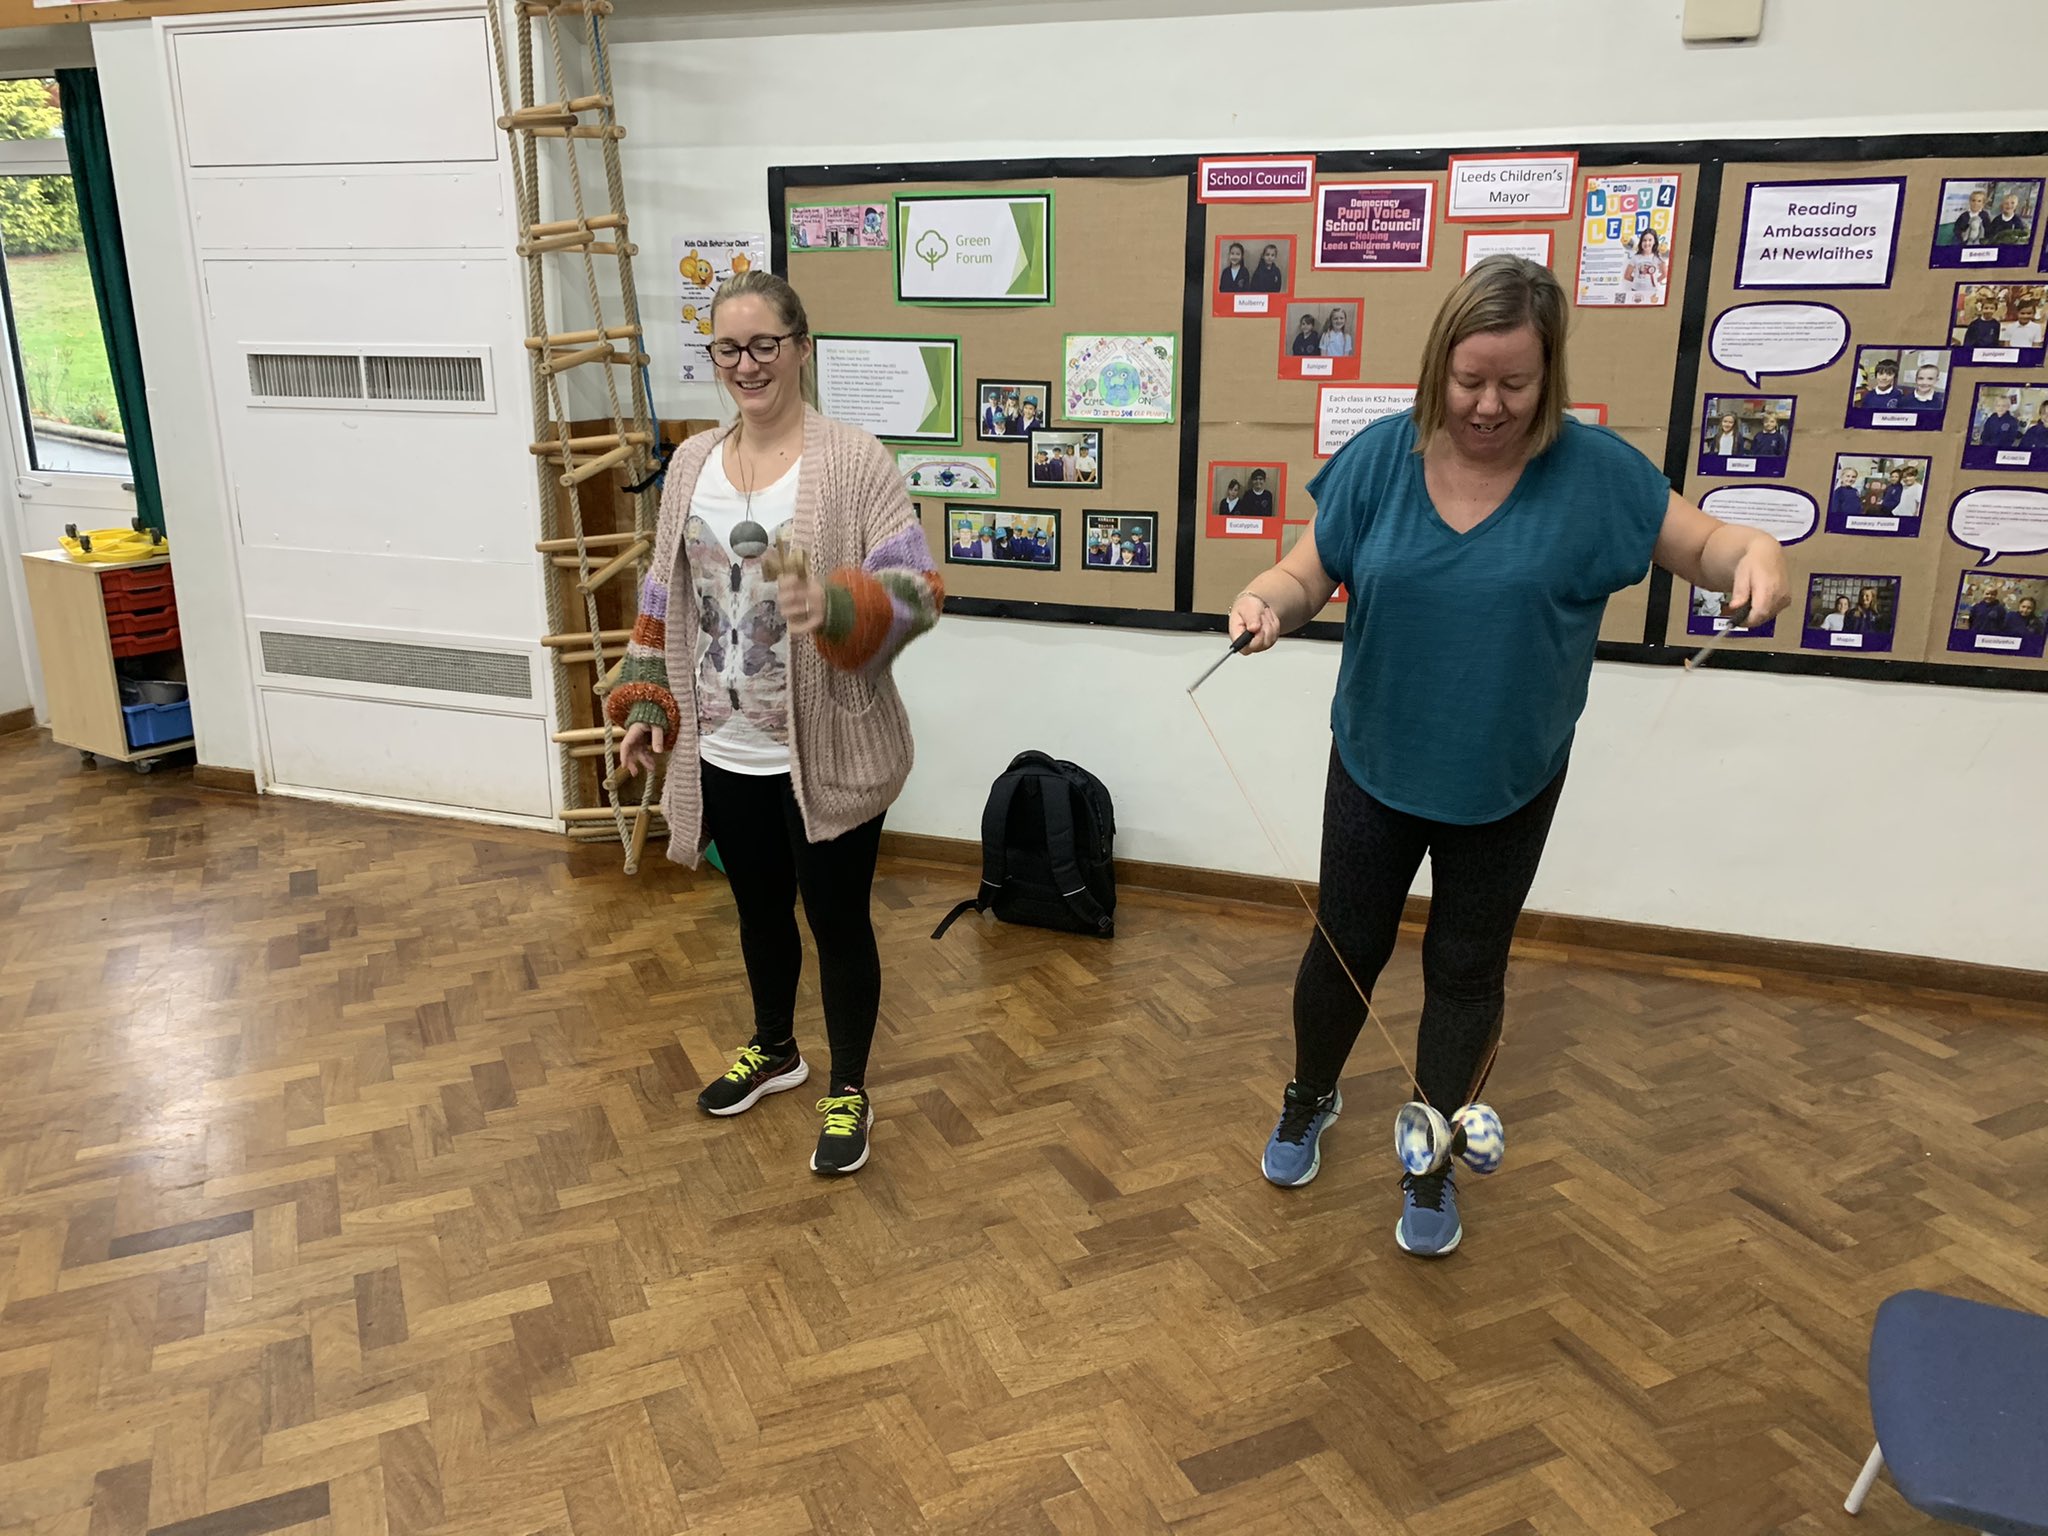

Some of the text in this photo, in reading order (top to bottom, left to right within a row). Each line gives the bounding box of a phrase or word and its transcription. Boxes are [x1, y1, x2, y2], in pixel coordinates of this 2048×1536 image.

[1209, 171, 1305, 185] School Council
[1461, 171, 1496, 182] Leeds
[1350, 198, 1400, 208] Democracy
[1489, 191, 1530, 204] Mayor
[1588, 186, 1674, 214] LUCY 4
[1337, 207, 1410, 220] Pupil Voice
[1787, 202, 1857, 217] Reading
[1325, 218, 1421, 231] School Council
[1588, 210, 1669, 241] LEEDS
[1763, 224, 1877, 238] Ambassadors
[955, 234, 991, 247] Green
[1355, 231, 1389, 241] Helping
[1323, 241, 1420, 251] Leeds Childrens Mayor
[956, 252, 993, 264] Forum
[1760, 247, 1873, 260] At Newlaithes
[1238, 299, 1265, 307] Mulberry
[1083, 397, 1152, 406] COME ON
[1330, 429, 1350, 437] every
